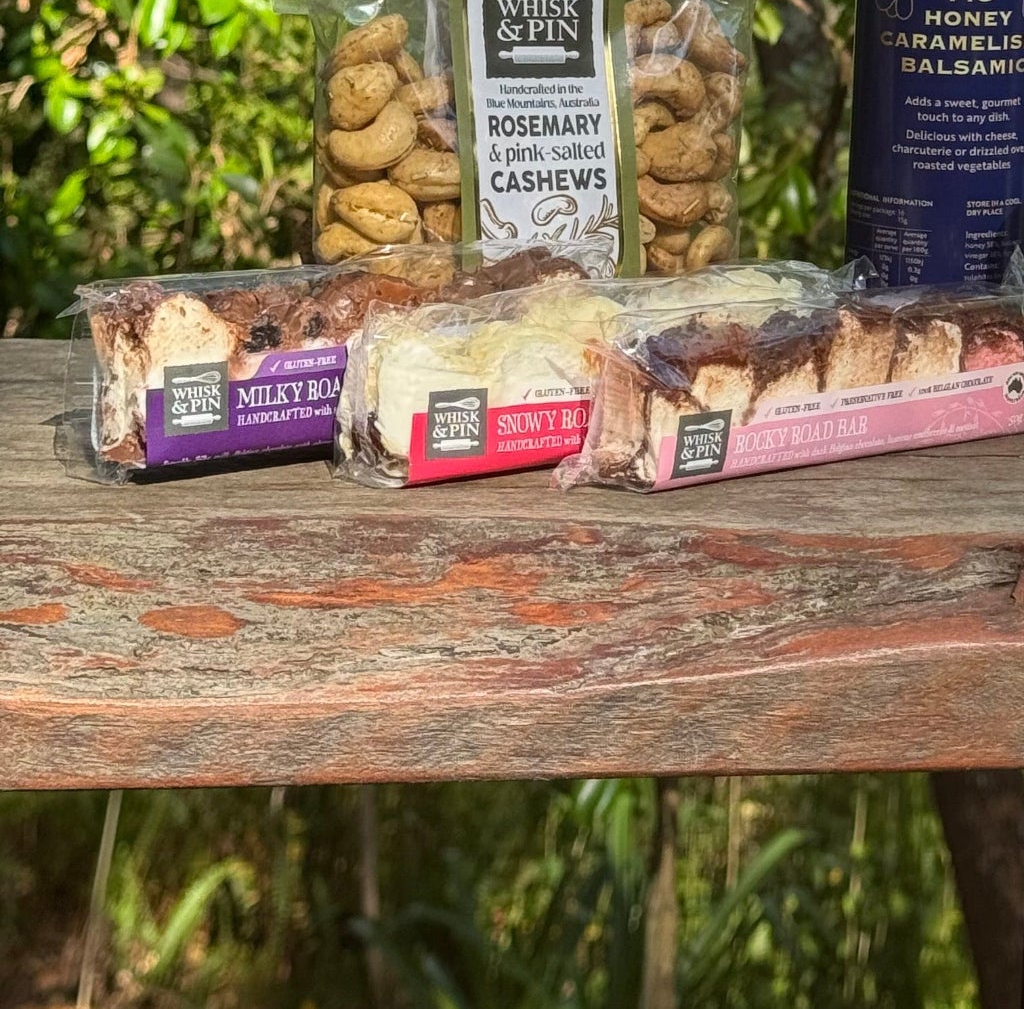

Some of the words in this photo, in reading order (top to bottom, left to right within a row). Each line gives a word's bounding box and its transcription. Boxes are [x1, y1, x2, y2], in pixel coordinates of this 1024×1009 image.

[924, 10, 1012, 26] HONEY
[497, 18, 522, 42] &
[528, 20, 579, 42] PIN
[499, 83, 555, 96] Handcrafted
[557, 83, 565, 96] in
[567, 84, 584, 95] the
[486, 98, 505, 109] Blue
[506, 97, 557, 110] Mountains,
[559, 97, 599, 108] Australia
[905, 95, 932, 108] Adds
[935, 99, 941, 108] a
[945, 98, 979, 110] sweet,
[982, 97, 1022, 111] gourmet
[488, 114, 601, 138] ROSEMARY
[918, 112, 949, 123] touch
[952, 113, 963, 123] to
[966, 114, 986, 126] any
[988, 112, 1010, 123] dish.
[906, 129, 956, 142] Delicious
[959, 131, 983, 142] with
[985, 131, 1018, 142] cheese,
[489, 144, 503, 162] &
[506, 141, 605, 166] pink-salted
[892, 144, 952, 157] charcuterie
[955, 148, 967, 157] or
[969, 145, 1009, 157] drizzled
[913, 160, 955, 172] roasted
[958, 159, 1011, 174] vegetables
[490, 167, 606, 193] CASHEWS
[966, 199, 990, 208] STORE
[1005, 198, 1023, 206] COOL
[966, 209, 981, 217] DRY
[983, 208, 1004, 216] PLACE
[284, 355, 337, 370] GLUTEN-FREE
[172, 385, 220, 401] WHISK
[236, 380, 303, 409] MILKY
[307, 376, 341, 402] ROA
[535, 386, 591, 399] GLUTEN-FREE
[887, 390, 903, 400] FREE
[933, 381, 961, 393] BELGIAN
[961, 376, 994, 389] CHOCOLATE
[171, 399, 188, 415] &
[191, 396, 221, 413] PIN
[237, 406, 313, 427] HANDCRAFTED
[314, 406, 332, 418] with
[433, 409, 480, 425] WHISK
[497, 408, 557, 437] SNOWY
[561, 407, 591, 430] RO
[432, 425, 448, 439] &
[449, 423, 480, 438] PIN
[683, 430, 724, 448] WHISK
[733, 427, 788, 454] ROCKY
[791, 420, 833, 446] ROAD
[837, 415, 868, 438] BAR
[497, 434, 563, 453] HANDCRAFTED
[564, 435, 581, 448] with
[681, 446, 696, 461] &
[697, 443, 723, 459] PIN
[730, 450, 794, 469] HANDCRAFTED
